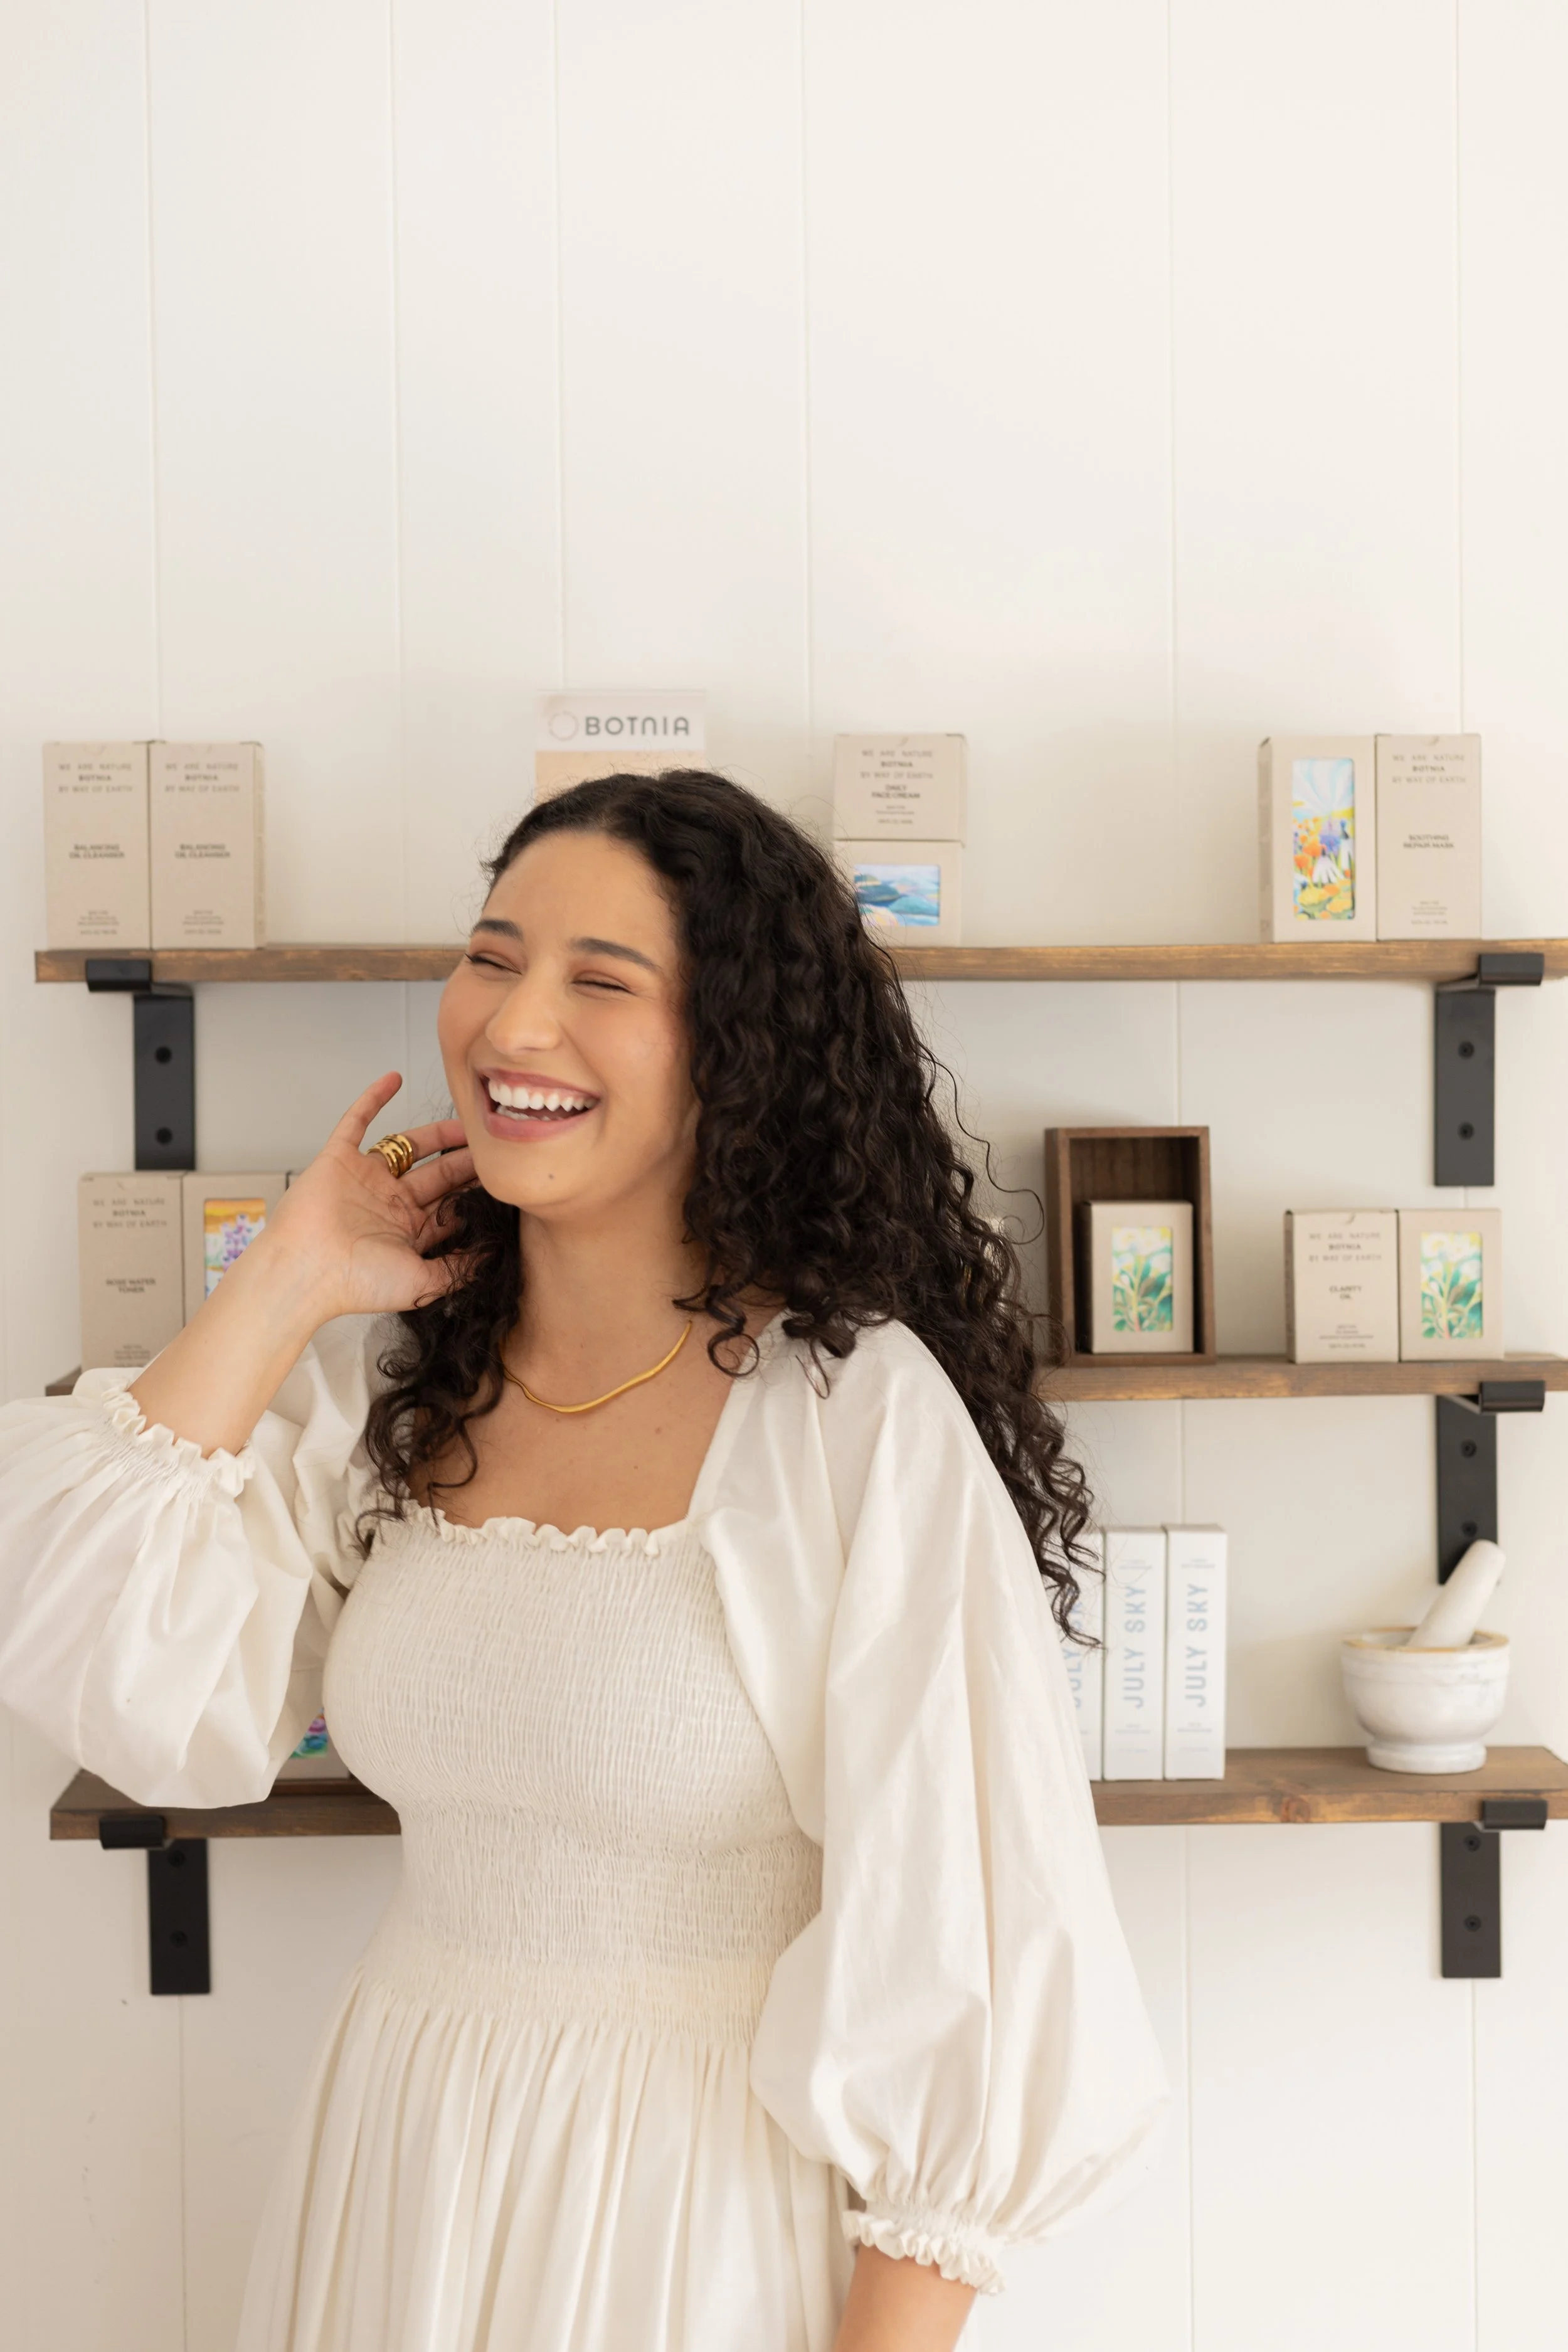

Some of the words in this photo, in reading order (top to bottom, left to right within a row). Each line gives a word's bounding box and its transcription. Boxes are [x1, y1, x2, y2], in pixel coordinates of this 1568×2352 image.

[585, 716, 690, 736] BOTNIA
[1125, 1585, 1145, 1633] SKY
[1187, 1582, 1208, 1632] SKY
[1123, 1647, 1145, 1708] JULY
[1185, 1646, 1207, 1707] JULY
